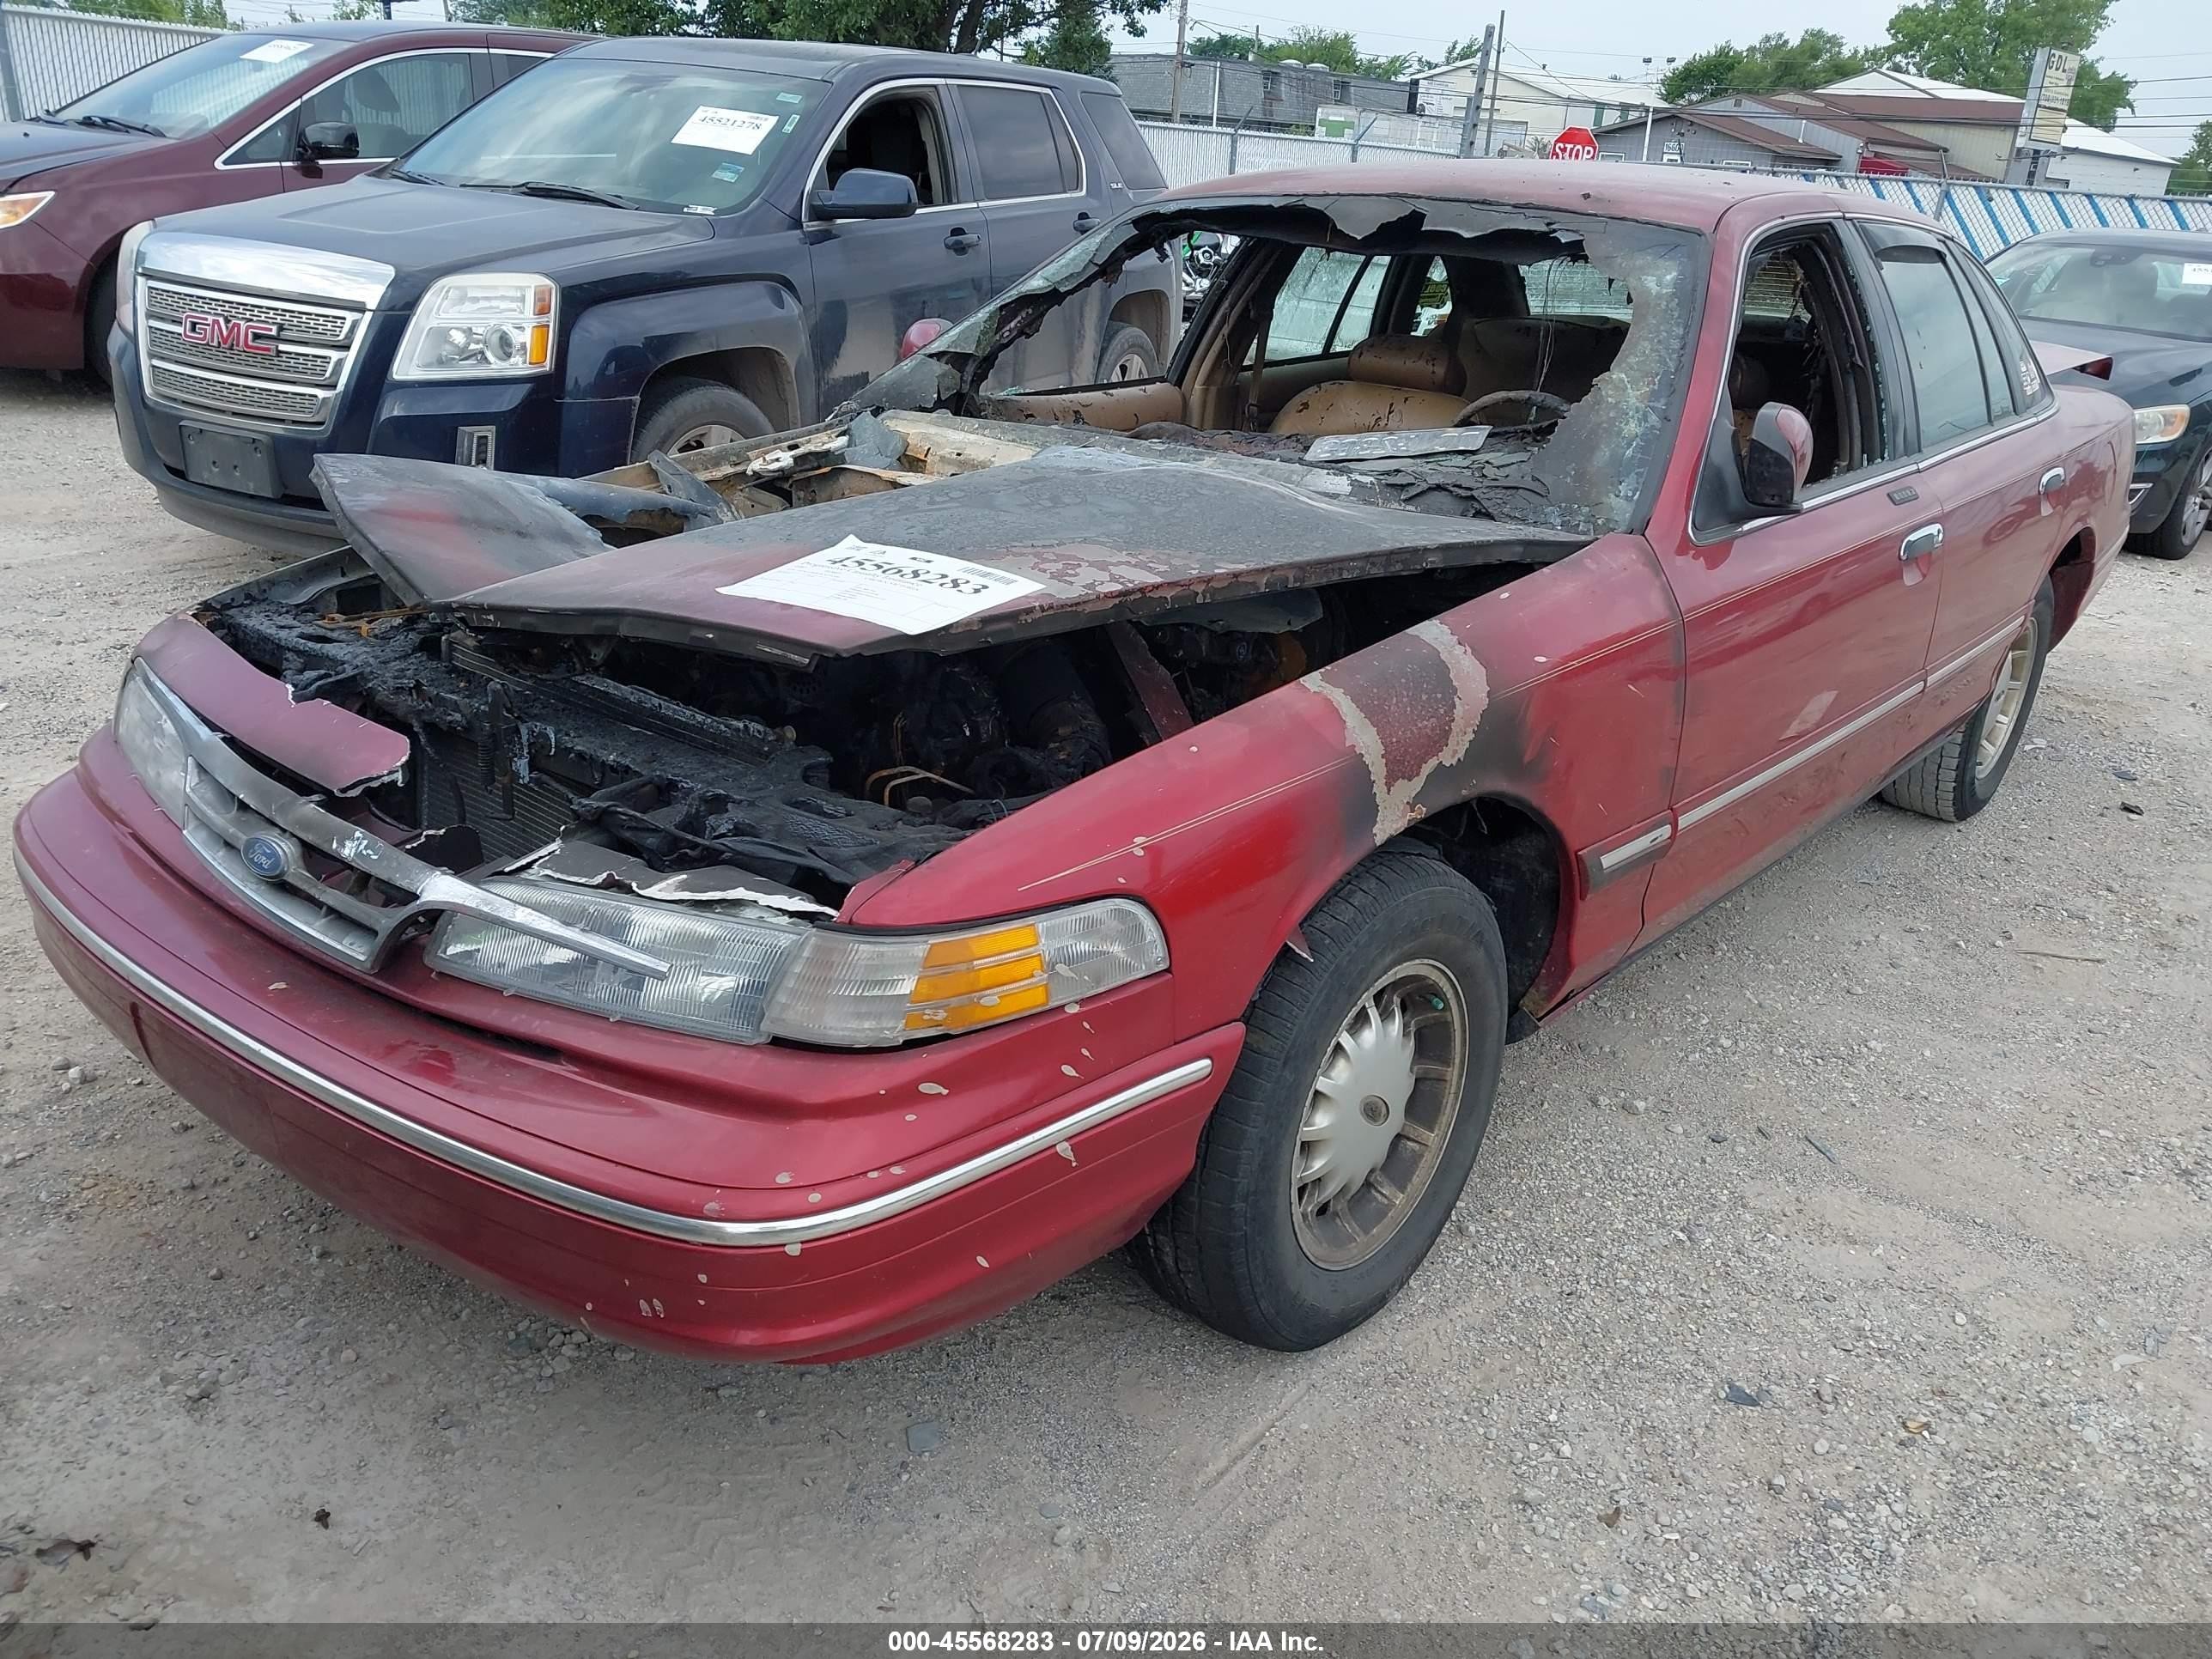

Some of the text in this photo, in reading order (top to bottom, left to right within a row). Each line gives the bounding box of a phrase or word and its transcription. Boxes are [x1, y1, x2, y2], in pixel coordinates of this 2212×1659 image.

[2048, 53, 2068, 73] GDL
[699, 115, 763, 131] 45521278
[1555, 143, 1594, 161] STOP
[182, 312, 277, 356] GMC
[826, 556, 990, 594] 45568283
[248, 842, 276, 869] Ford
